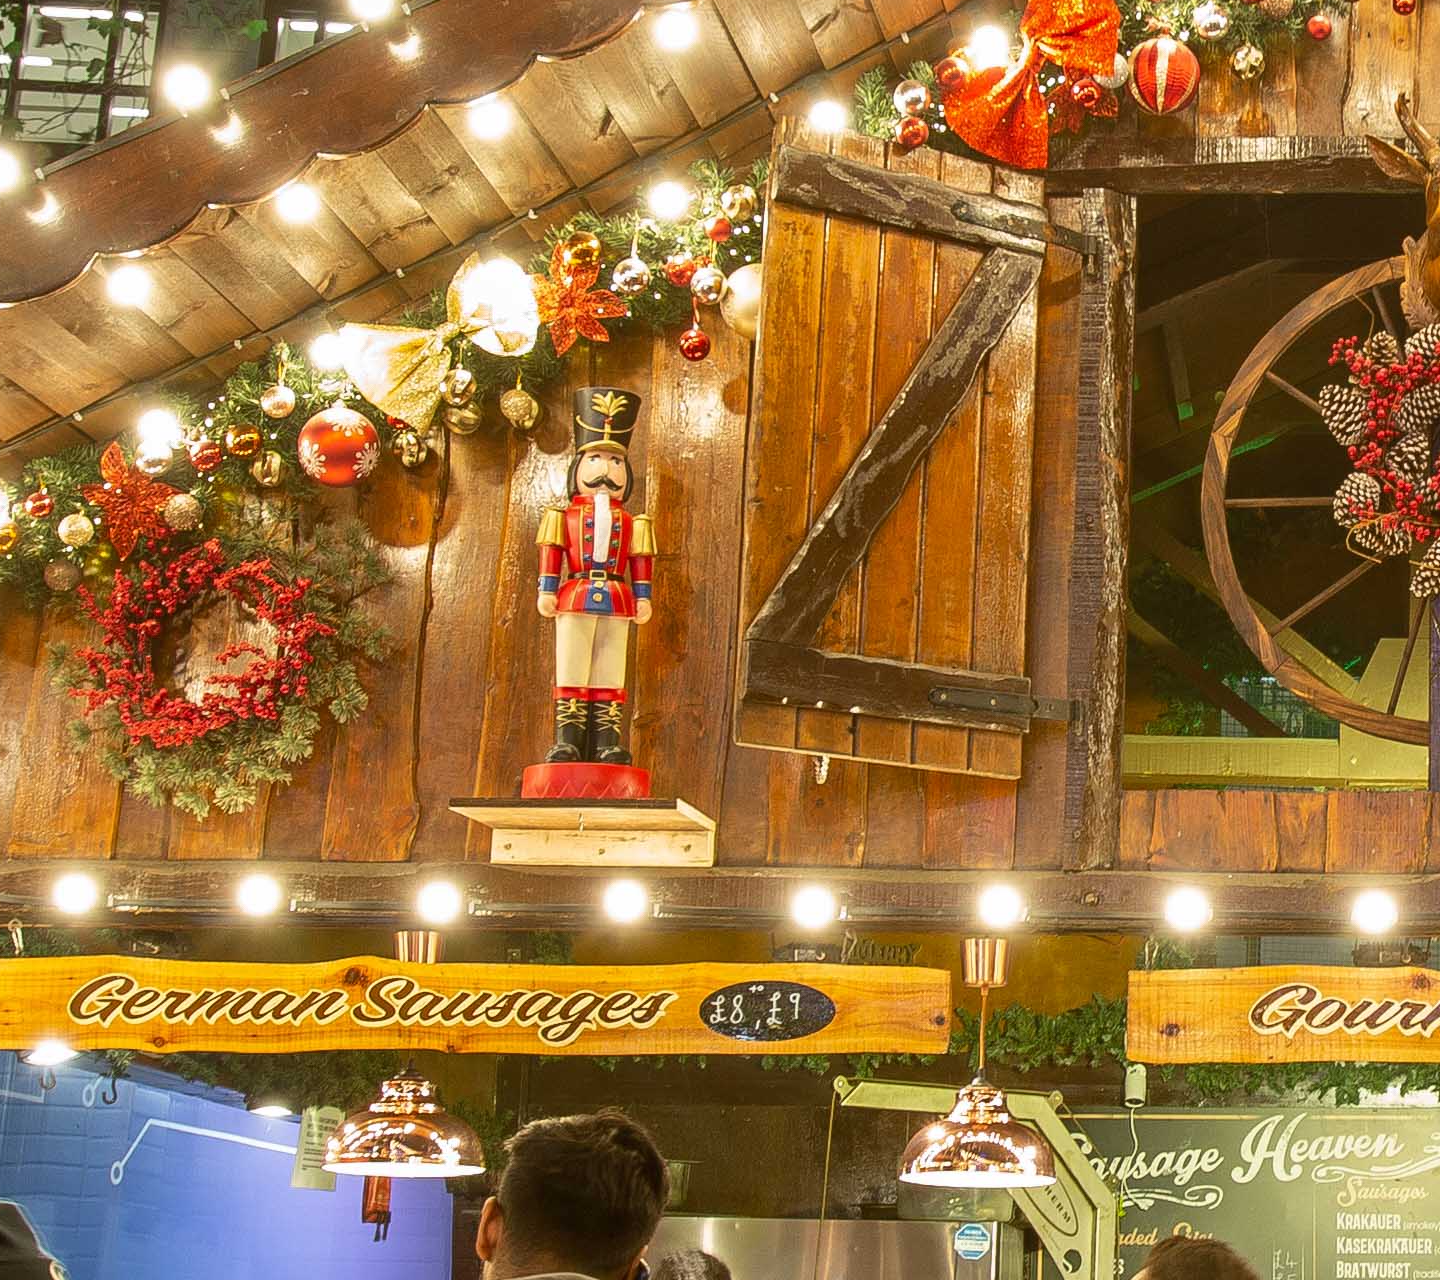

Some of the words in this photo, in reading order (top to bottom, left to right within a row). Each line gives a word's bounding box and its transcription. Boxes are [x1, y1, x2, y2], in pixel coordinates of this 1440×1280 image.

[68, 974, 348, 1027] German
[350, 975, 679, 1047] Sausages
[1231, 1111, 1405, 1185] Heaven
[1337, 1176, 1430, 1207] Sausages
[1336, 1211, 1402, 1231] KRAKAUER
[1336, 1236, 1433, 1255] KASEKRAKAUER
[1335, 1261, 1412, 1280] BRATWURST
